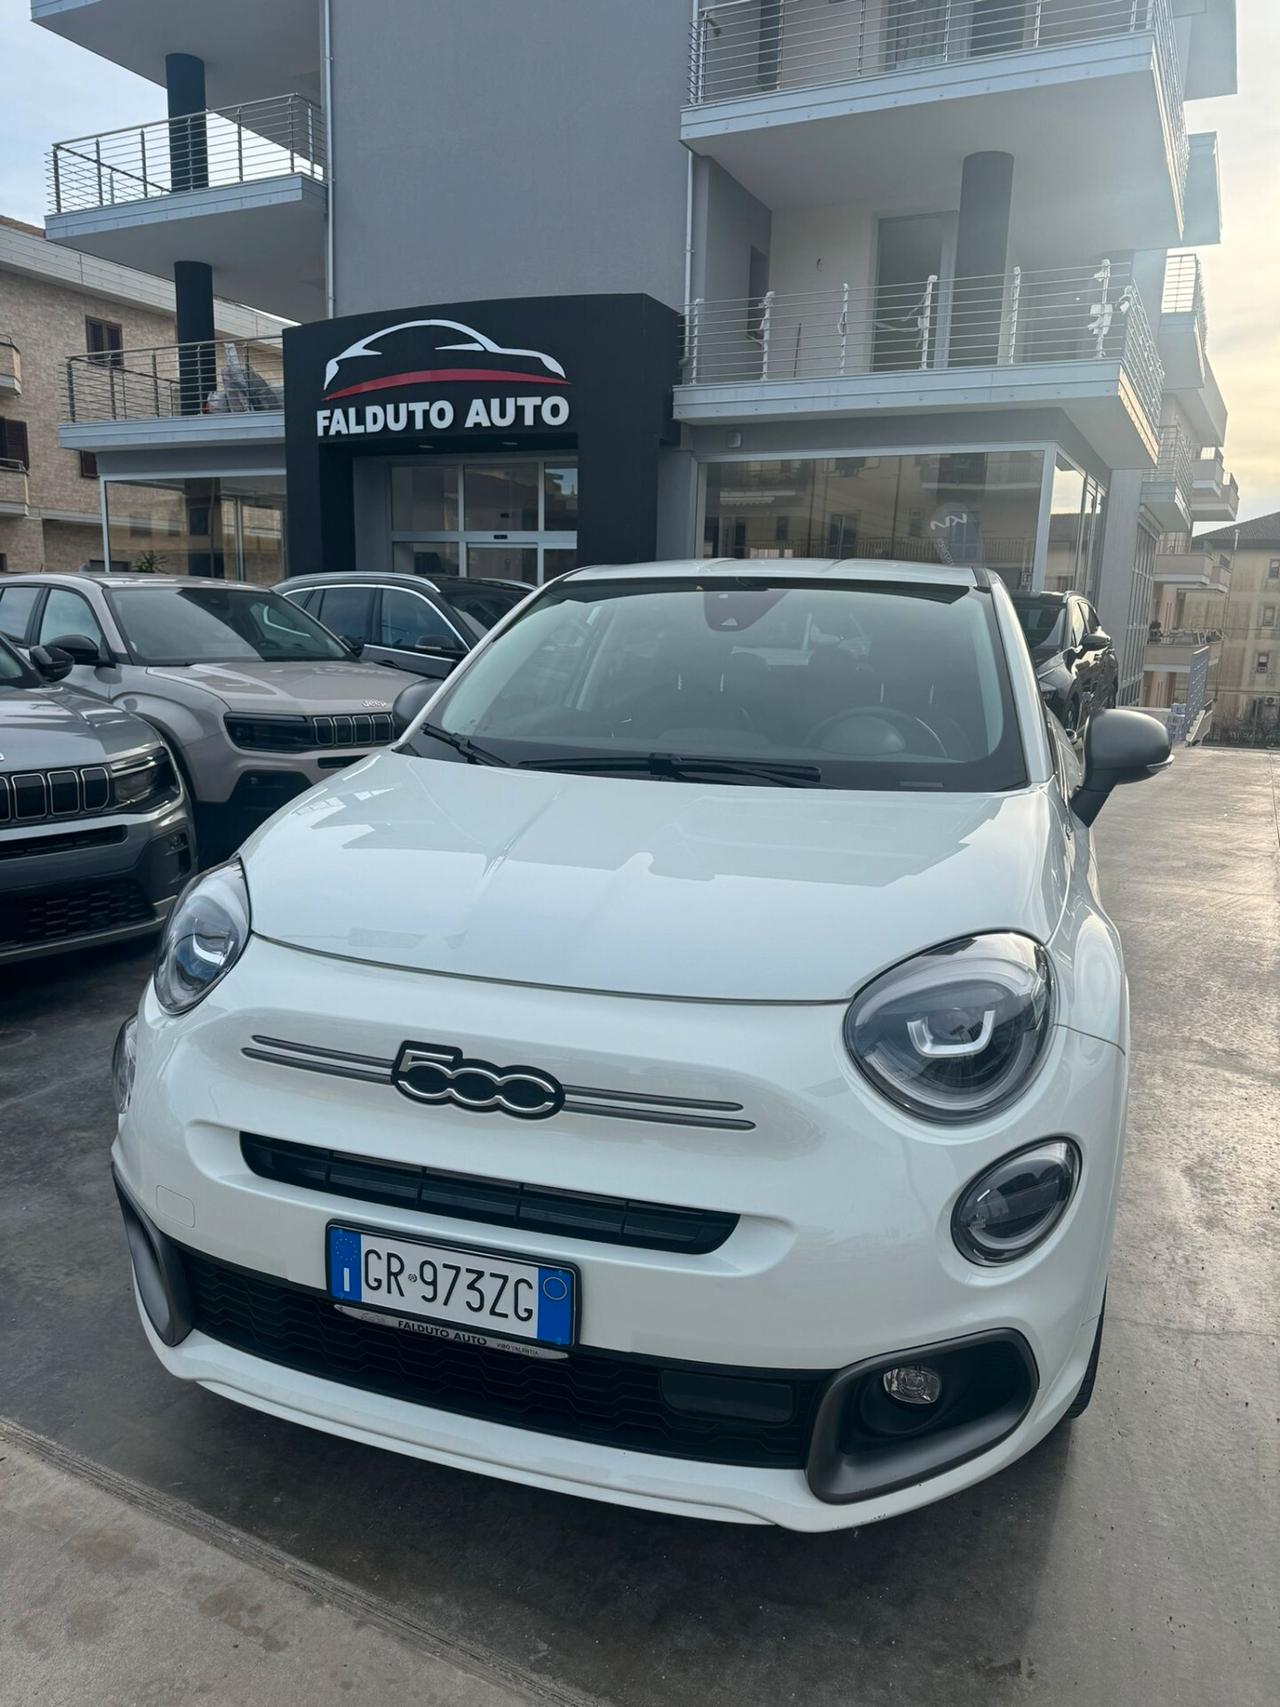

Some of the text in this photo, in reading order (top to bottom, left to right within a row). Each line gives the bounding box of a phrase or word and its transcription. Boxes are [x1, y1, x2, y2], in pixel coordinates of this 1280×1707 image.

[316, 395, 570, 437] FALDUTO AUTO
[393, 1042, 563, 1118] 500
[364, 1249, 534, 1322] GR 973ZG
[398, 1320, 450, 1338] FALDUTO
[454, 1332, 488, 1346] AUTO
